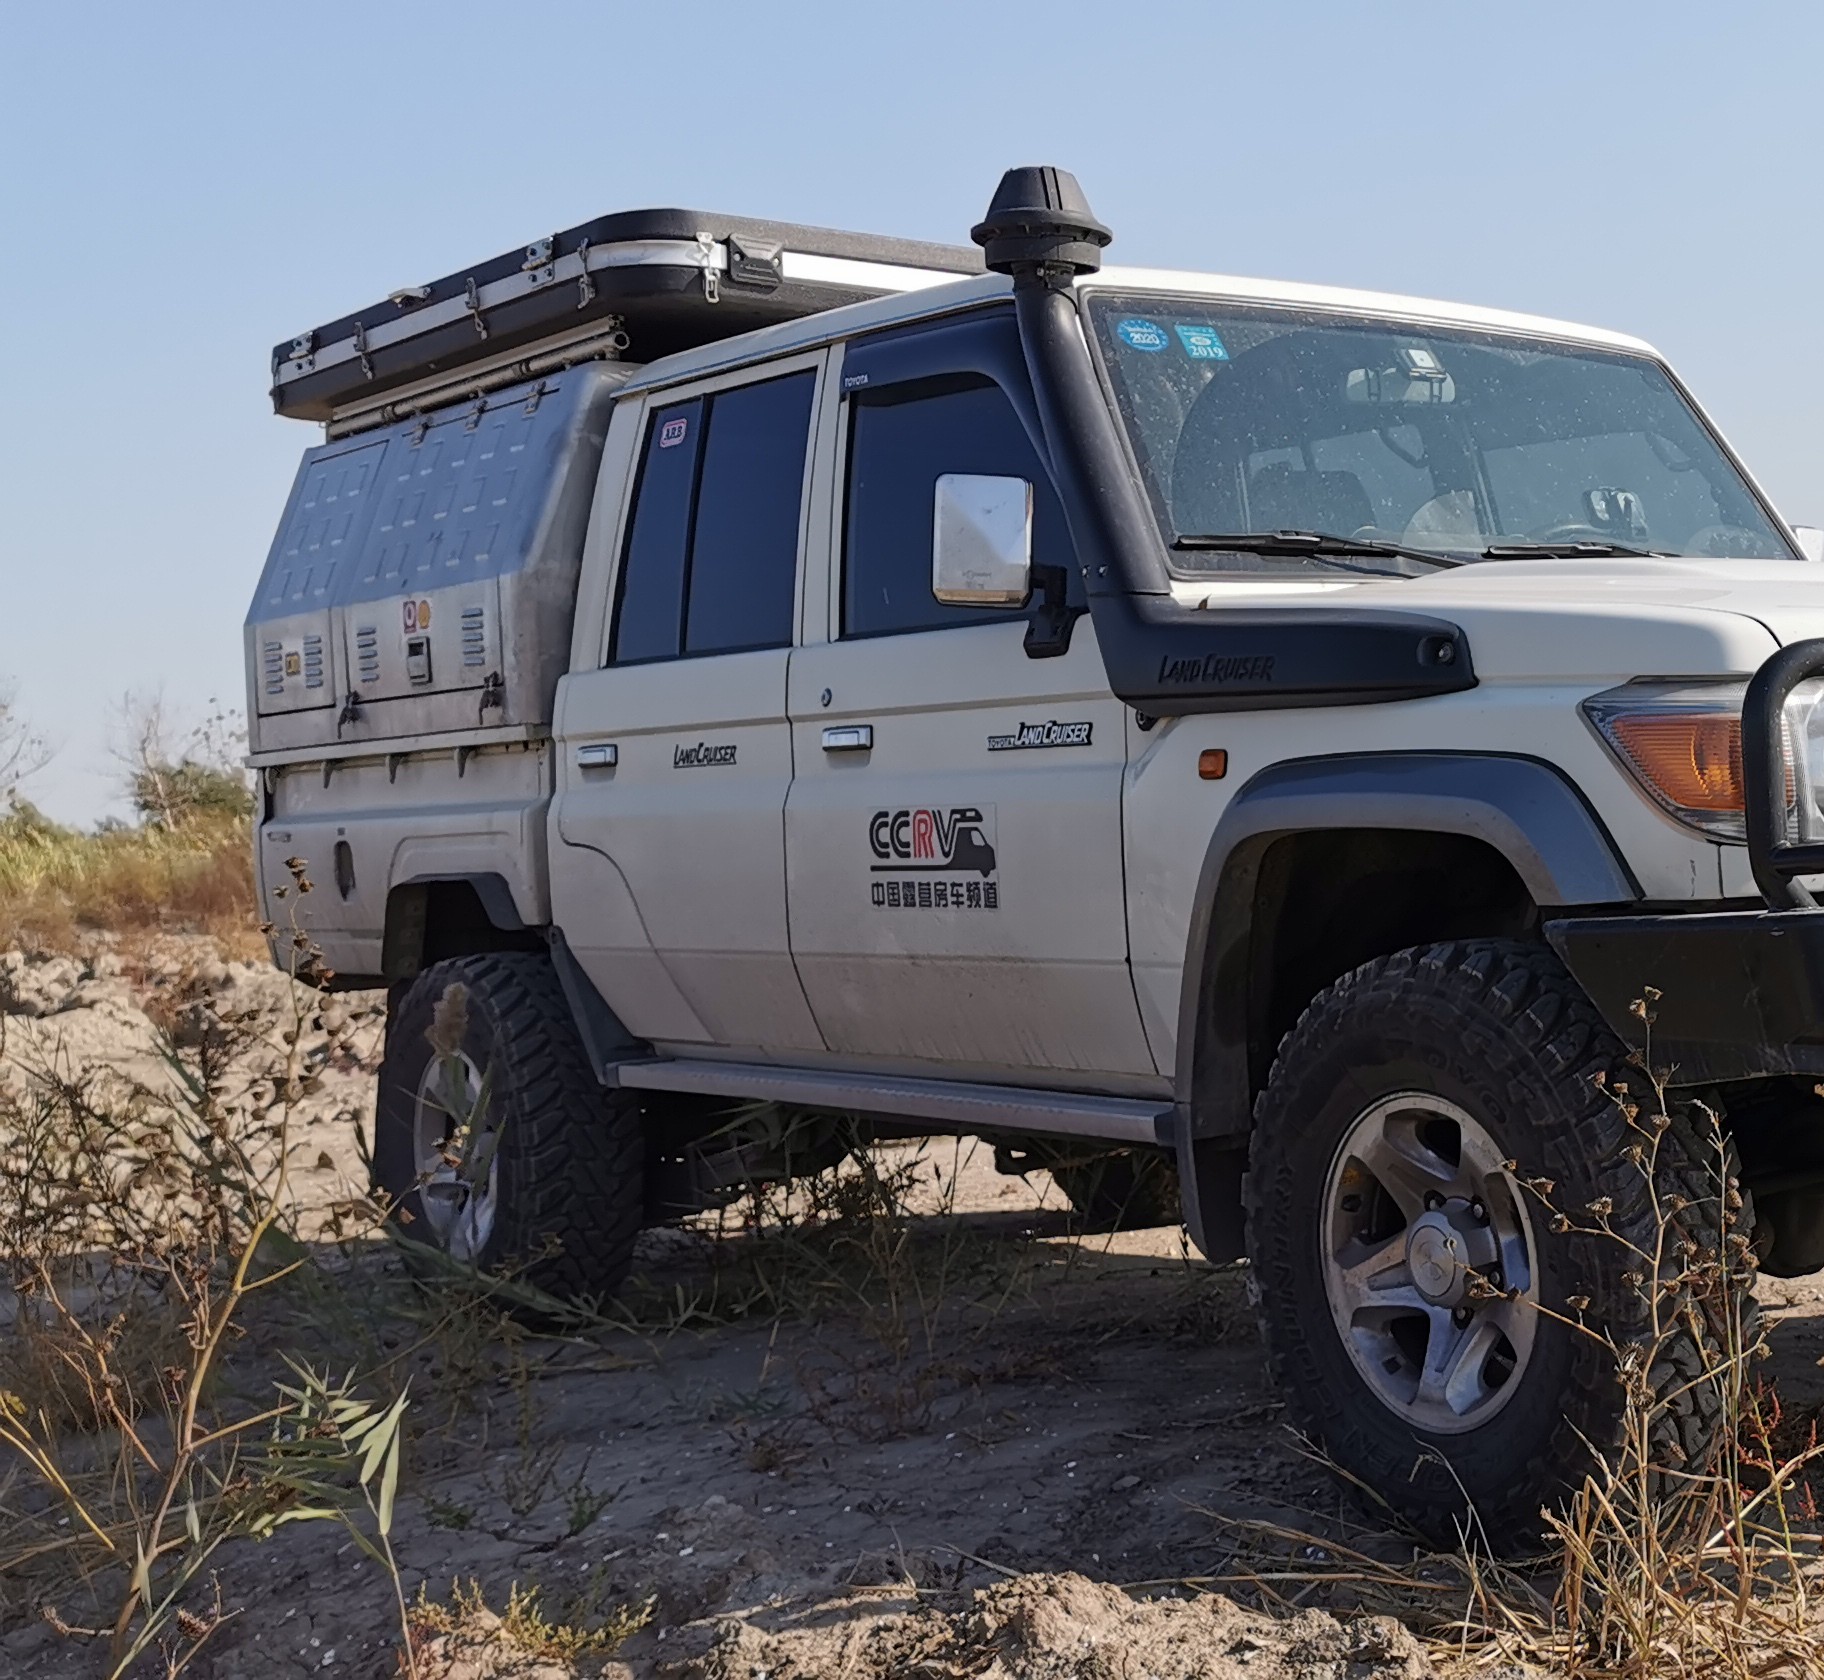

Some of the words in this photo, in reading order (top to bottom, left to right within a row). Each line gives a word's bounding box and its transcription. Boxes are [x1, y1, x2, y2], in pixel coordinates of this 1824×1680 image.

[1129, 332, 1161, 345] 2020
[1190, 345, 1224, 358] 2019
[869, 809, 959, 859] CCRV
[871, 881, 999, 909] 中国露营房车频道
